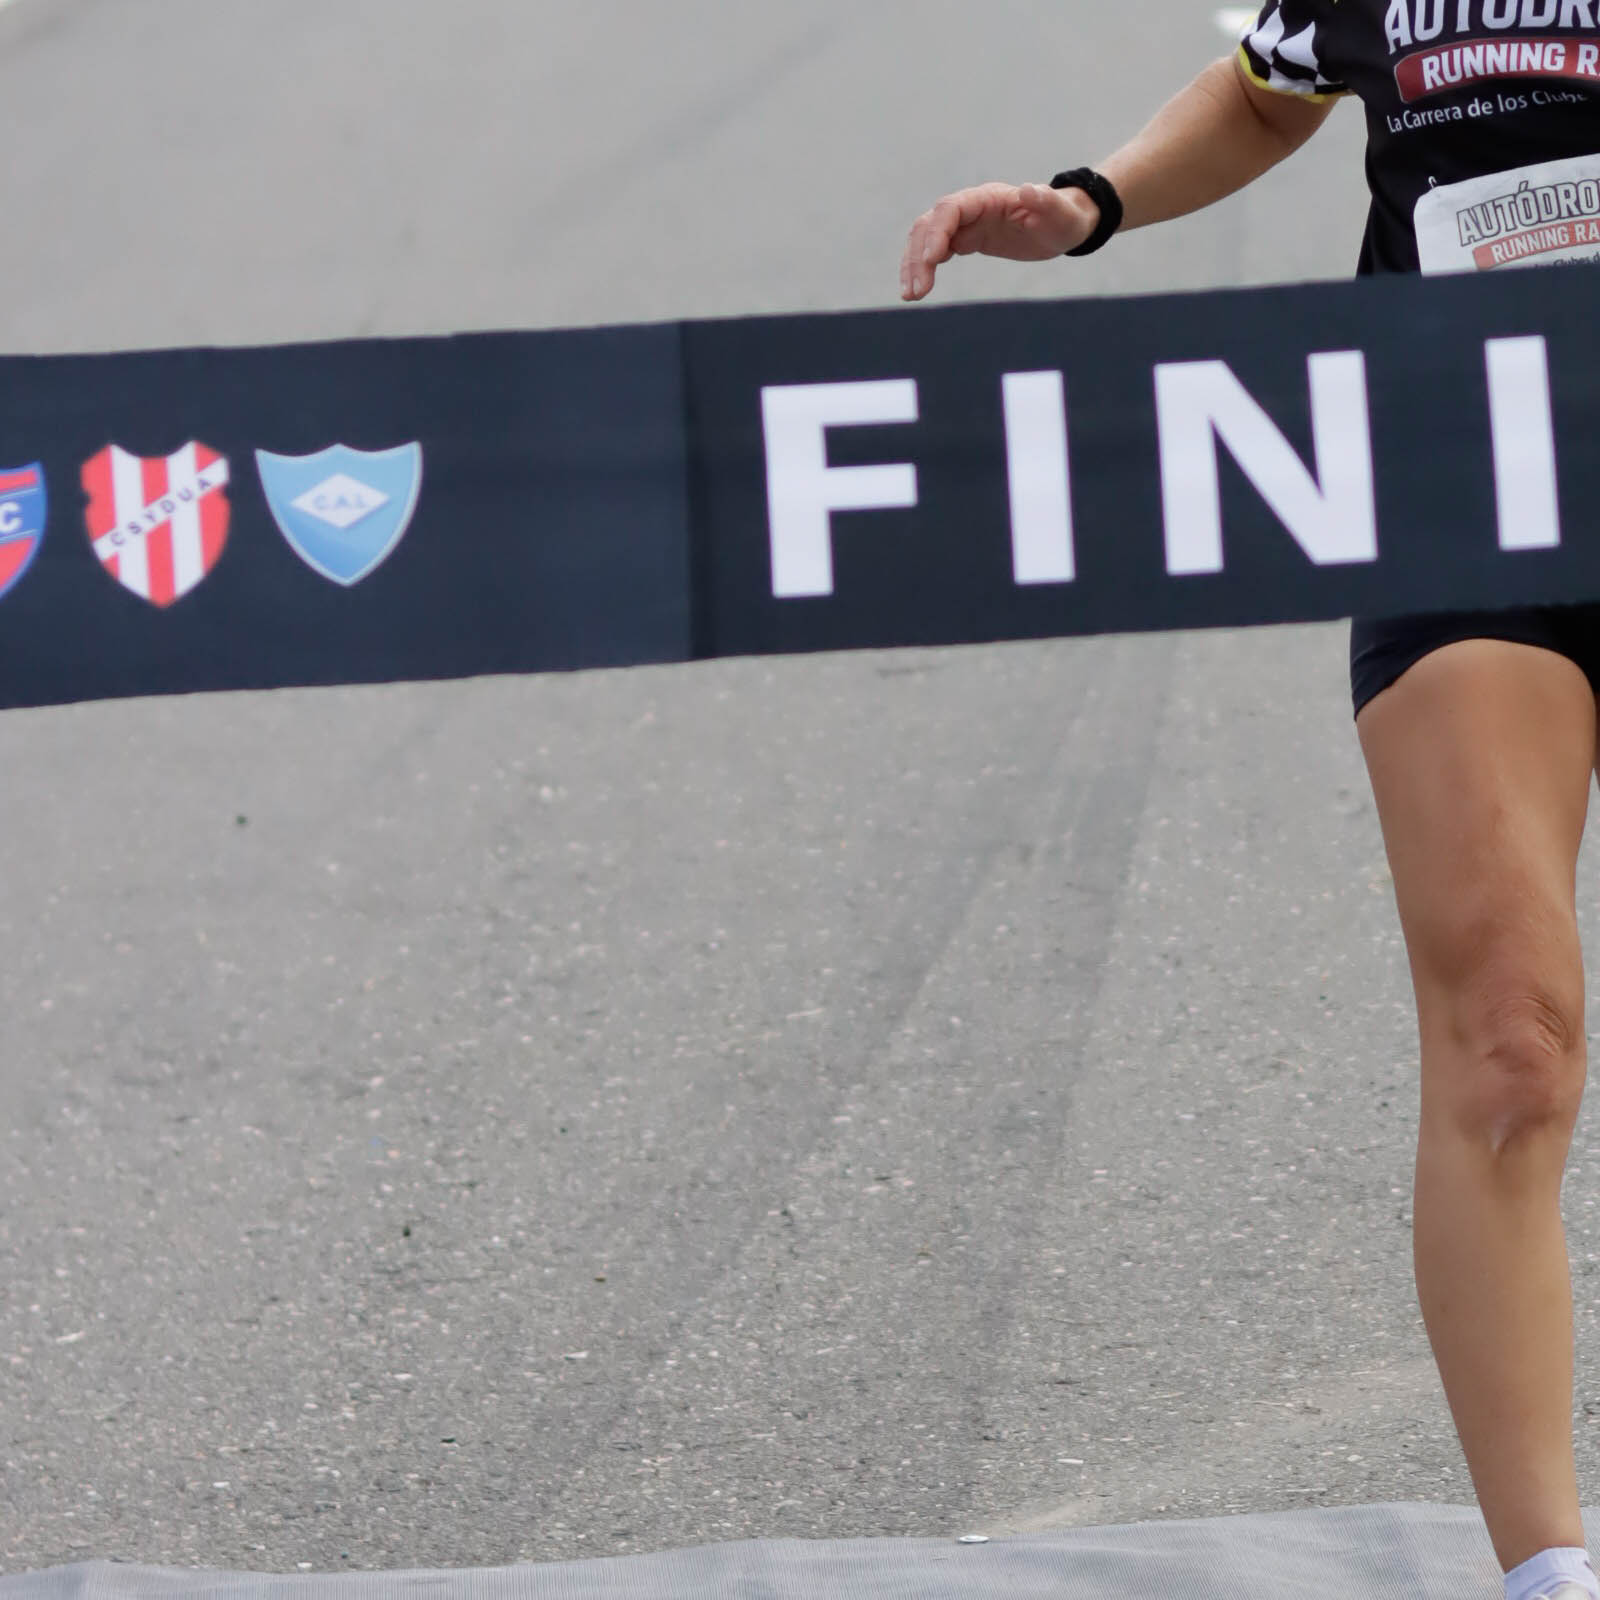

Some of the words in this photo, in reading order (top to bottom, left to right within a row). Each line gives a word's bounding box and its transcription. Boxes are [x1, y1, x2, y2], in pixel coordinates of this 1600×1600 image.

[1421, 42, 1566, 91] RUNNING
[1387, 113, 1402, 133] La
[1403, 102, 1463, 130] Carrera
[1467, 97, 1493, 120] de
[1498, 94, 1528, 113] los
[1490, 225, 1570, 264] RUNNING
